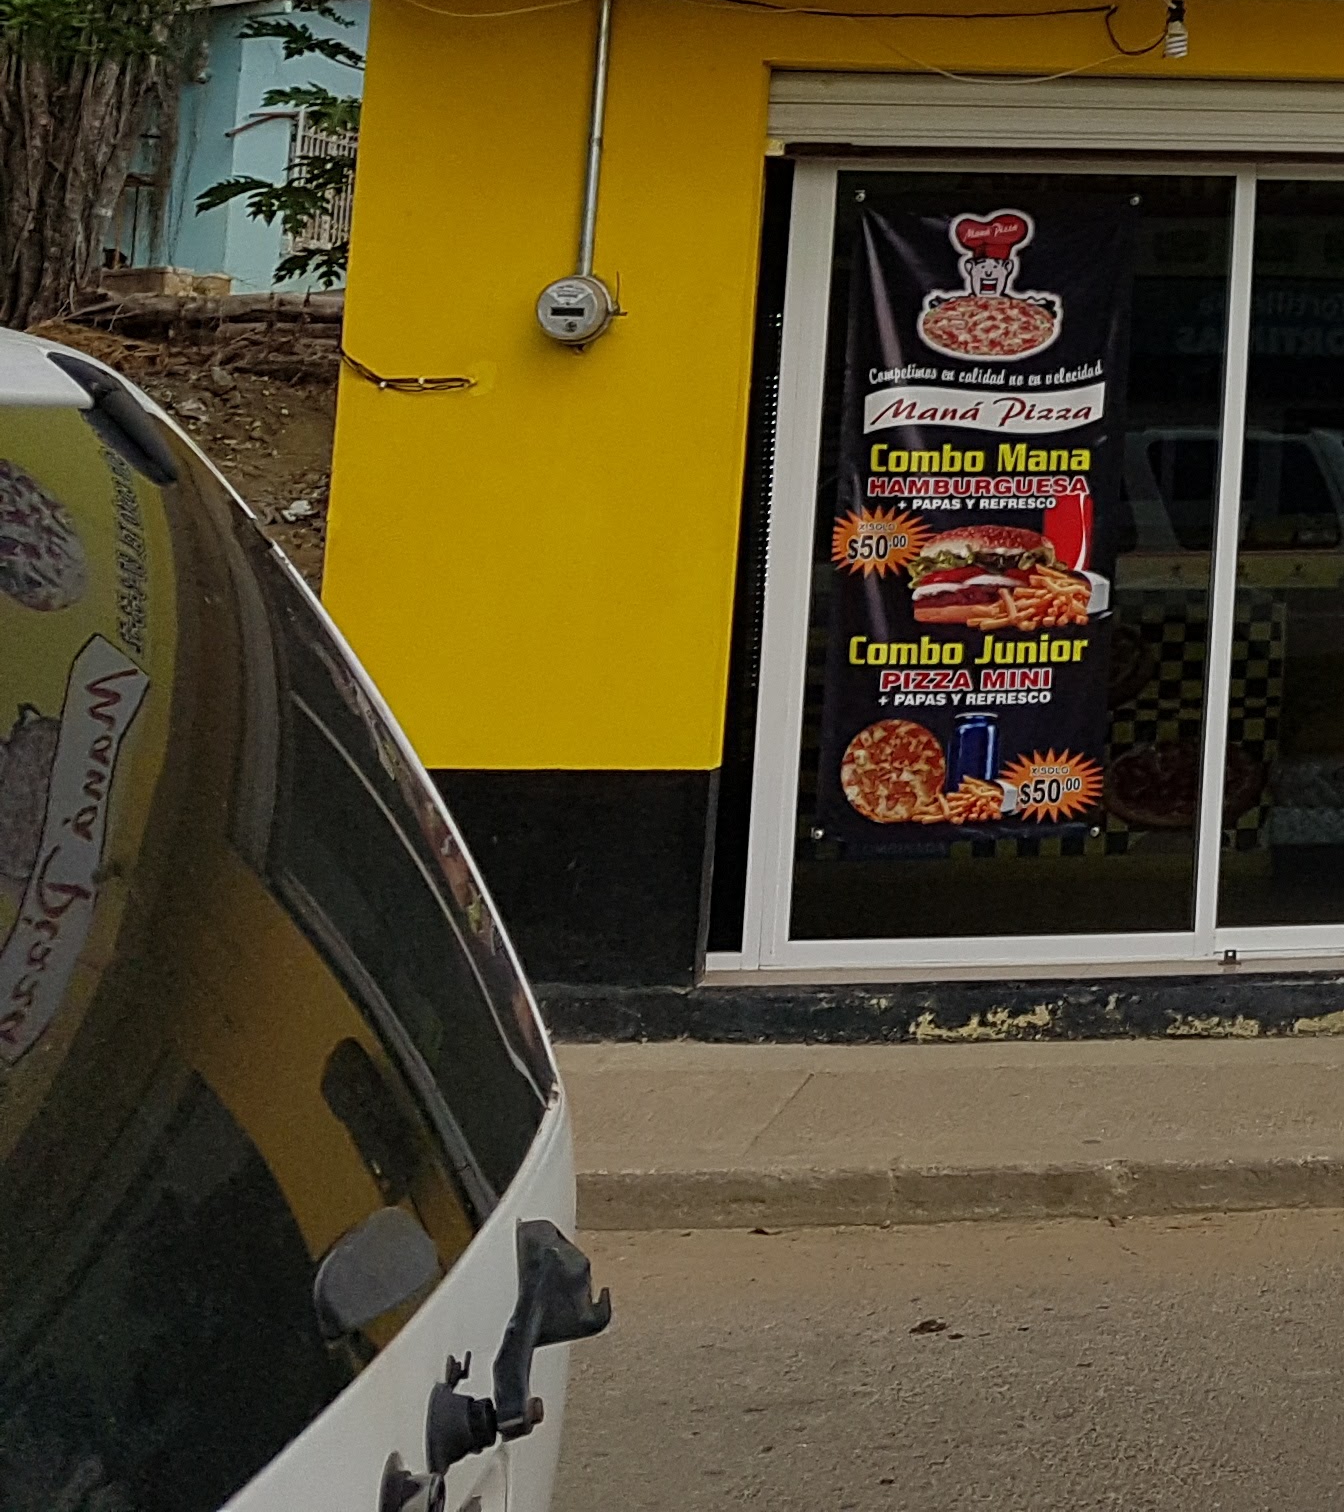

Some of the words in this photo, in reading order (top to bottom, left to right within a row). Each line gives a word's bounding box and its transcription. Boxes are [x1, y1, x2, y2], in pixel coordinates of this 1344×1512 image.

[869, 397, 986, 427] Maná
[991, 396, 1093, 428] Pizza
[869, 442, 986, 473] Combo
[996, 441, 1092, 473] Mana
[866, 474, 1090, 498] HAMBURGUESA
[897, 499, 909, 511] +
[911, 496, 962, 511] PAPAS
[965, 497, 978, 510] Y
[979, 496, 1058, 510] REFRESCO
[848, 634, 965, 666] Combo
[973, 633, 1089, 665] Junior
[879, 668, 974, 692] PIZZA
[979, 667, 1053, 692] MINI
[877, 695, 889, 707] +
[893, 694, 948, 707] PAPAS
[951, 693, 963, 706] Y
[964, 691, 1052, 706] REFRESCO
